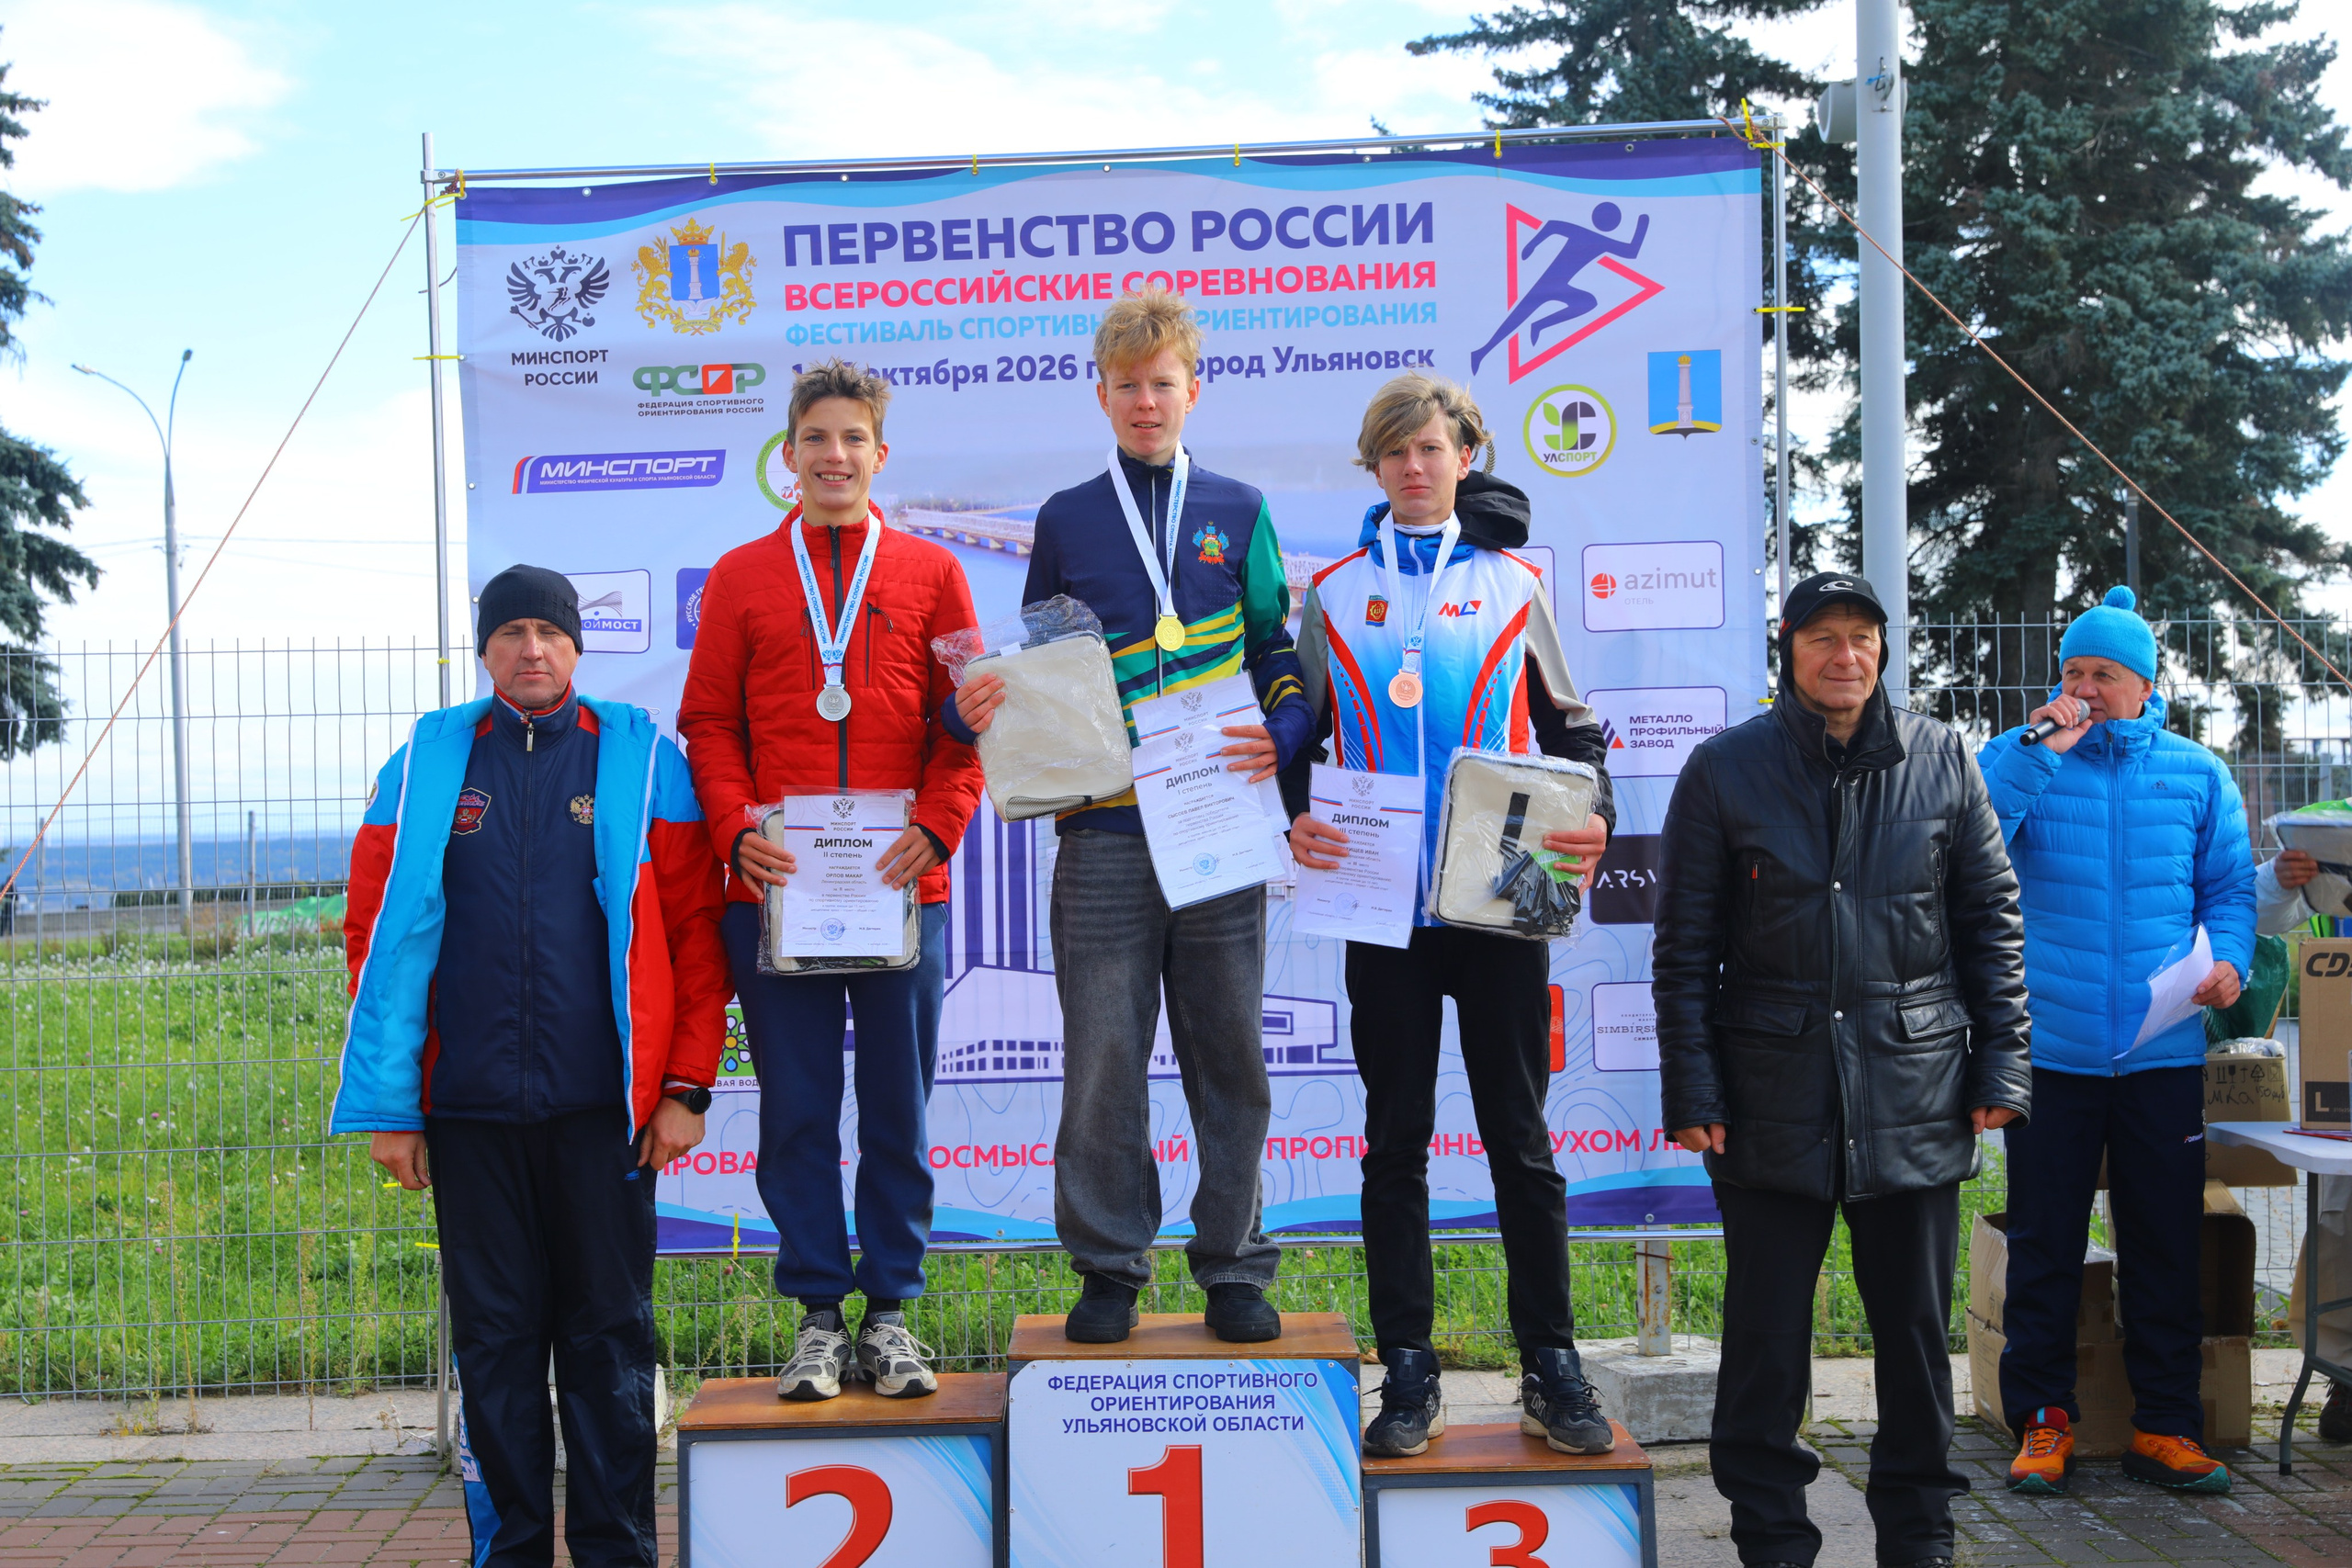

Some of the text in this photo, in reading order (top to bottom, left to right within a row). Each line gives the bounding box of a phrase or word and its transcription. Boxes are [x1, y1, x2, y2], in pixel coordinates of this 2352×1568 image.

[783, 201, 1434, 267] ПЕРВЕНСТВО РОССИИ
[785, 261, 1437, 311] ВСЕРОССИЙСКИЕ СОРЕВНОВАНИЯ
[786, 302, 1438, 346] ФЕСТИВАЛЬ СПОРТИВН РИЕНТИРОВАНИЯ
[511, 349, 609, 366] МИНСПОРТ
[996, 354, 1079, 383] 2026
[1272, 345, 1435, 375] Ульяновск
[524, 370, 599, 387] РОССИИ
[638, 398, 764, 410] ФЕДЕРАЦИЯ СПОРТИВНОГО
[638, 406, 764, 417] ОРИЕНТИРОВАНИЯ РОССИИ
[540, 457, 717, 478] МИНСПОРТ
[1170, 479, 1182, 524] МИНИСТЕРСТВО
[1624, 568, 1716, 591] azimut
[685, 592, 698, 623] РУССКОЕ
[800, 554, 827, 644] МИНИСТЕРСТВО СПОРТА РОССИИ
[839, 554, 869, 644] МИНИСТЕРСТВО СПОРТА РОССИИ
[1624, 597, 1654, 605] ОТЕЛЬ
[1629, 714, 1692, 724] МЕТАЛЛО
[1630, 724, 1724, 737] ПРОФИЛЬНЫЙ
[1630, 739, 1674, 750] ЗАВОД
[1165, 764, 1220, 789] ДИПЛОМ
[1182, 783, 1213, 795] степень
[1331, 813, 1390, 829] ДИПЛОМ
[814, 838, 873, 849] ДИПЛОМ
[1348, 829, 1380, 838] степень
[2314, 1091, 2330, 1112] L
[1548, 1129, 1641, 1155] УХОМ
[1047, 1372, 1318, 1393] ФЕДЕРАЦИЯ СПОРТИВНОГО
[1091, 1394, 1275, 1412] ОРИЕНТИРОВАНИЯ
[1062, 1414, 1305, 1434] УЛЬЯНОВСКОЙ ОБЛАСТИ
[786, 1463, 893, 1568] 2
[1127, 1444, 1204, 1568] 1
